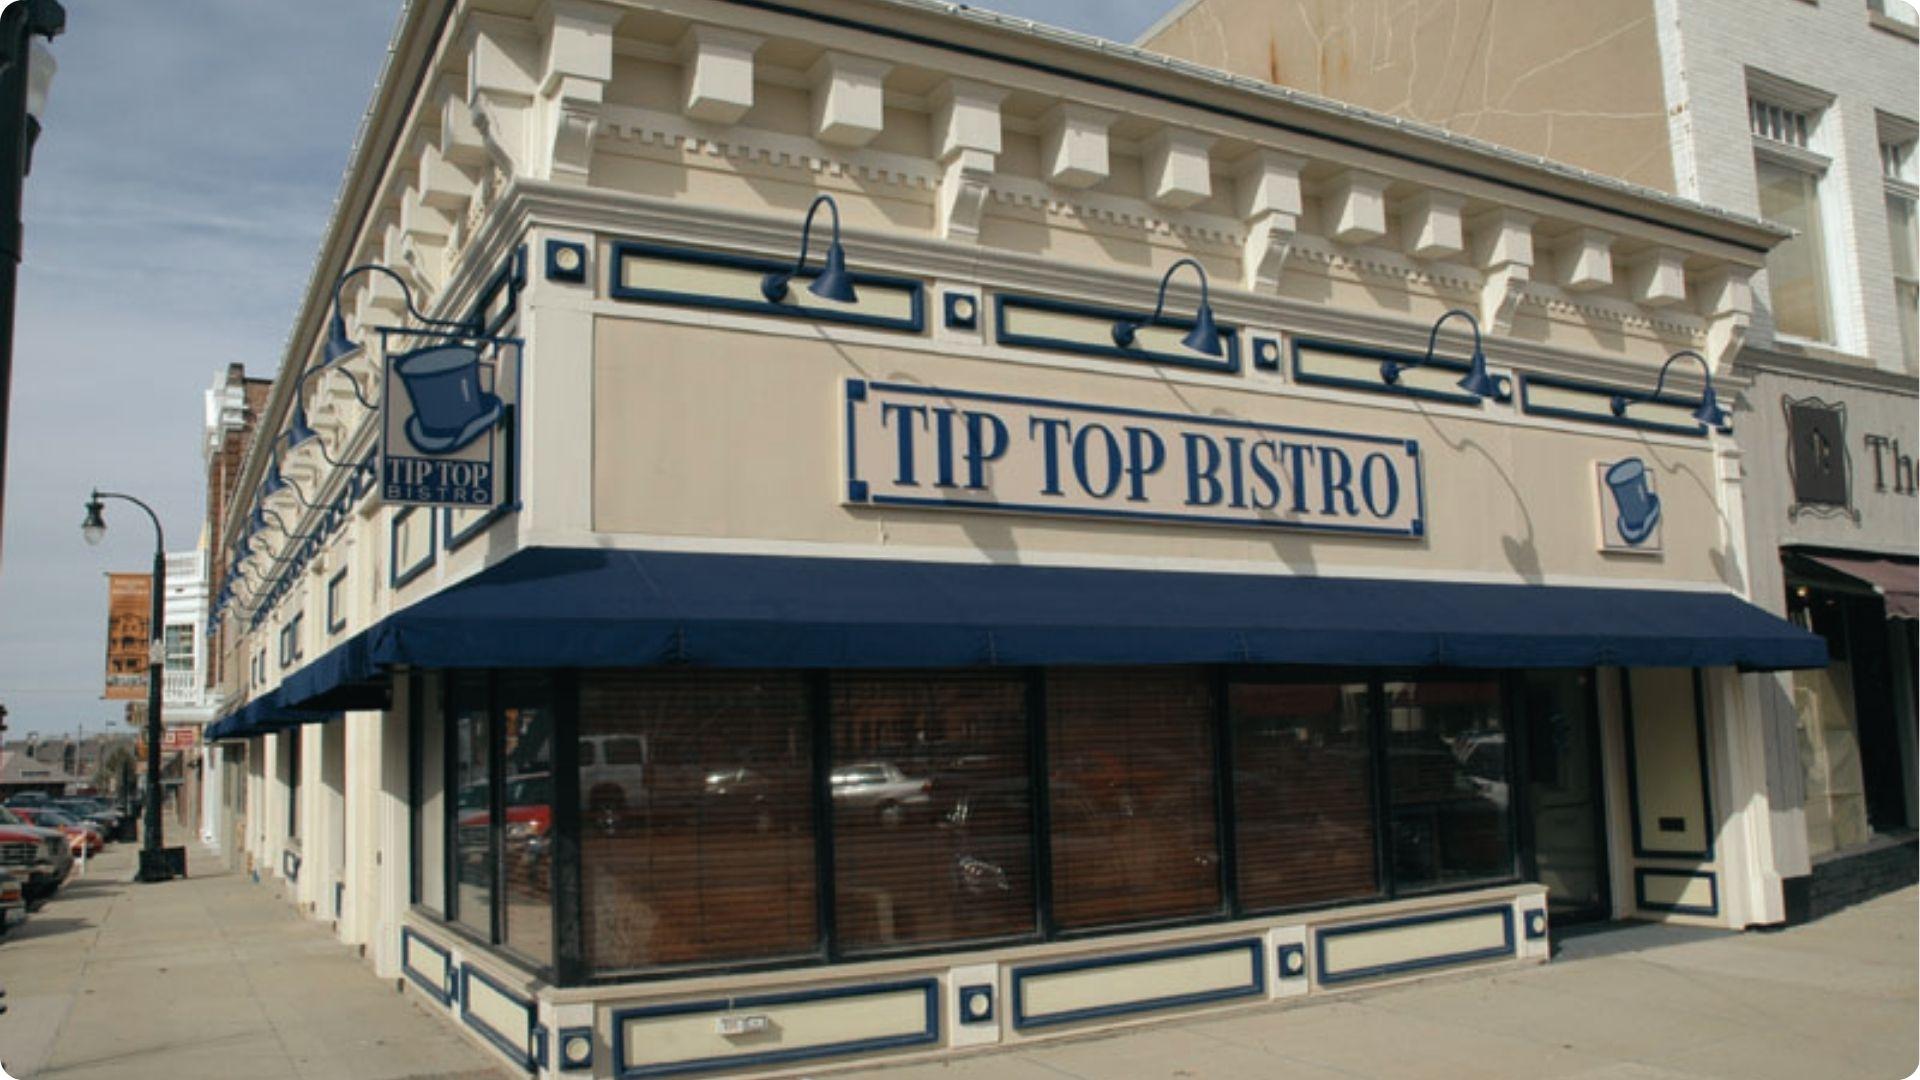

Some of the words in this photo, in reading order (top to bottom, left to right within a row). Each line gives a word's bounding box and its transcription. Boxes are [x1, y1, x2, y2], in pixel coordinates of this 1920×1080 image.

[387, 458, 432, 485] TIP
[438, 461, 489, 488] TOP
[881, 401, 1010, 490] TIP
[1029, 414, 1166, 501] TOP
[1181, 431, 1400, 519] BISTRO
[1864, 432, 1919, 497] Th
[388, 484, 488, 503] BISTRO
